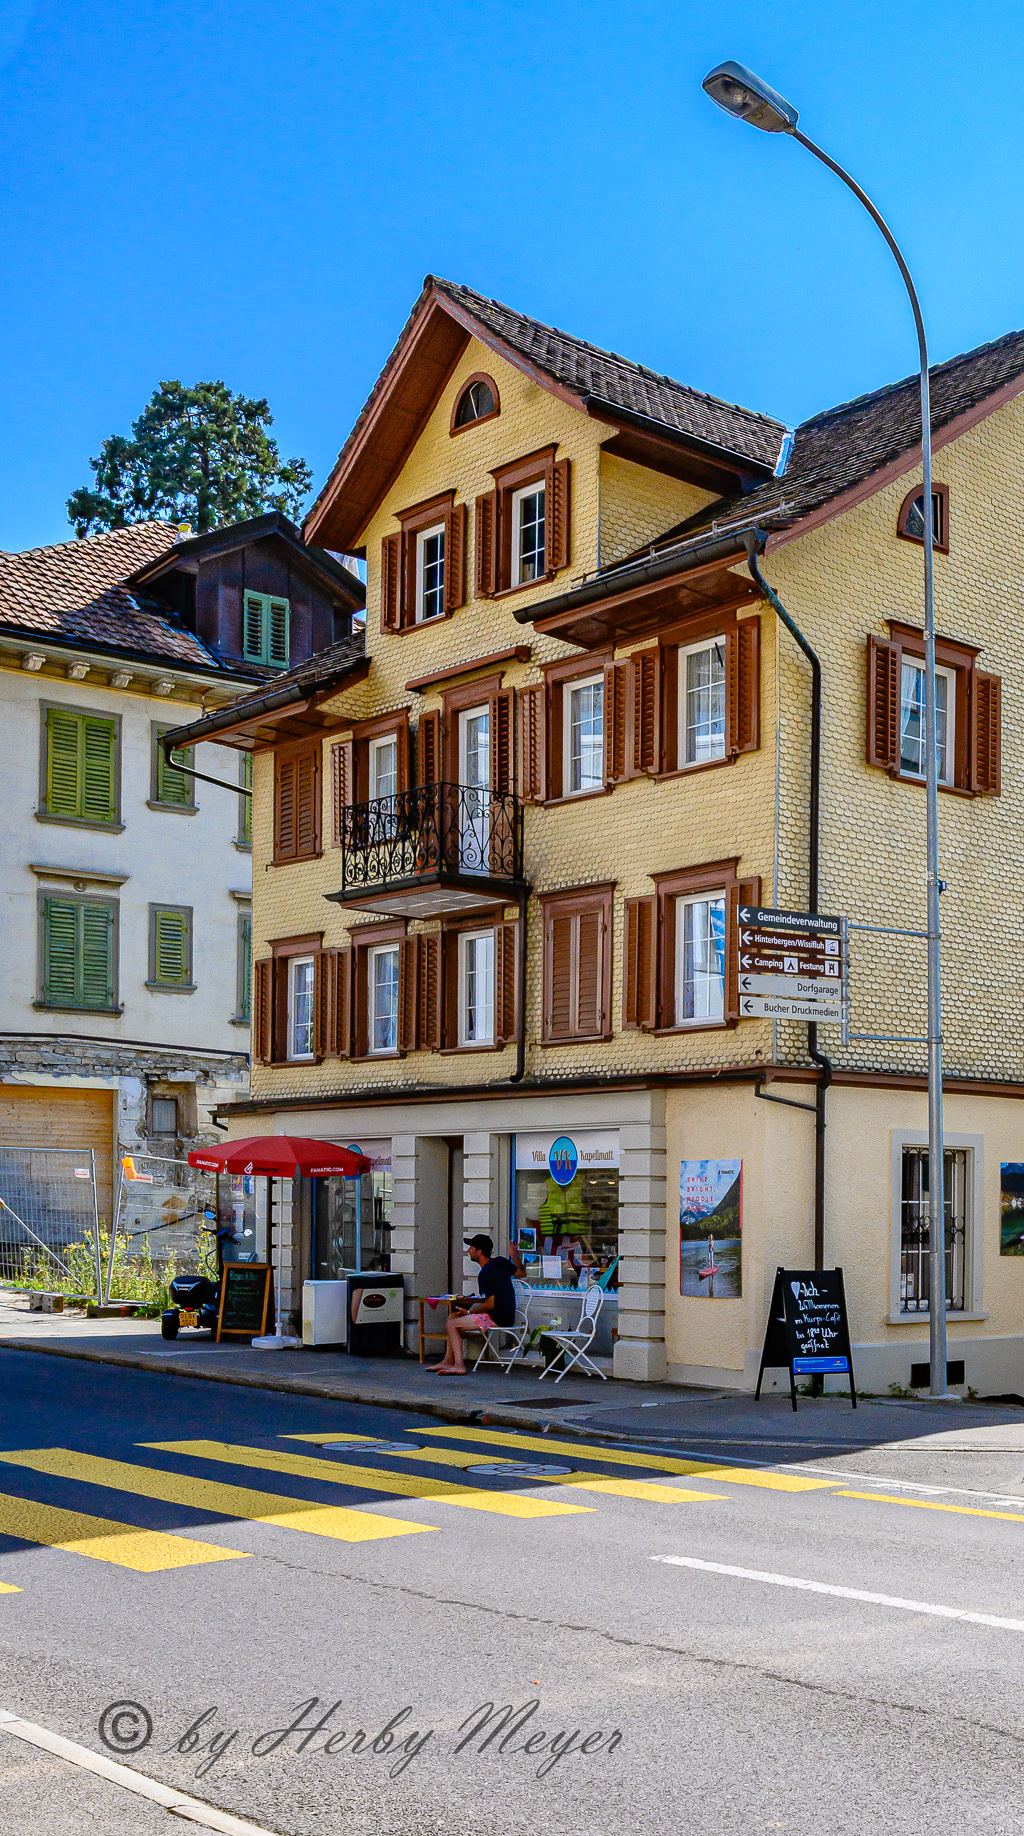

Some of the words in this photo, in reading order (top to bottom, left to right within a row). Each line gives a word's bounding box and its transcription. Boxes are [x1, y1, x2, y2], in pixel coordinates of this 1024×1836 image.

[757, 911, 838, 931] Gemeindeverwaltung
[754, 934, 825, 950] Hinterbergen/Wissifluh
[754, 957, 783, 969] Camping
[799, 961, 824, 973] Festung
[797, 982, 839, 996] Dorfgarage
[764, 1002, 789, 1013] Bucher
[791, 1004, 839, 1017] Druckmedien
[531, 1150, 546, 1162] Villa
[579, 1149, 614, 1163] Kapellmatt
[310, 1166, 344, 1174] FANATIC.COM
[686, 1185, 716, 1193] BRIGHT,
